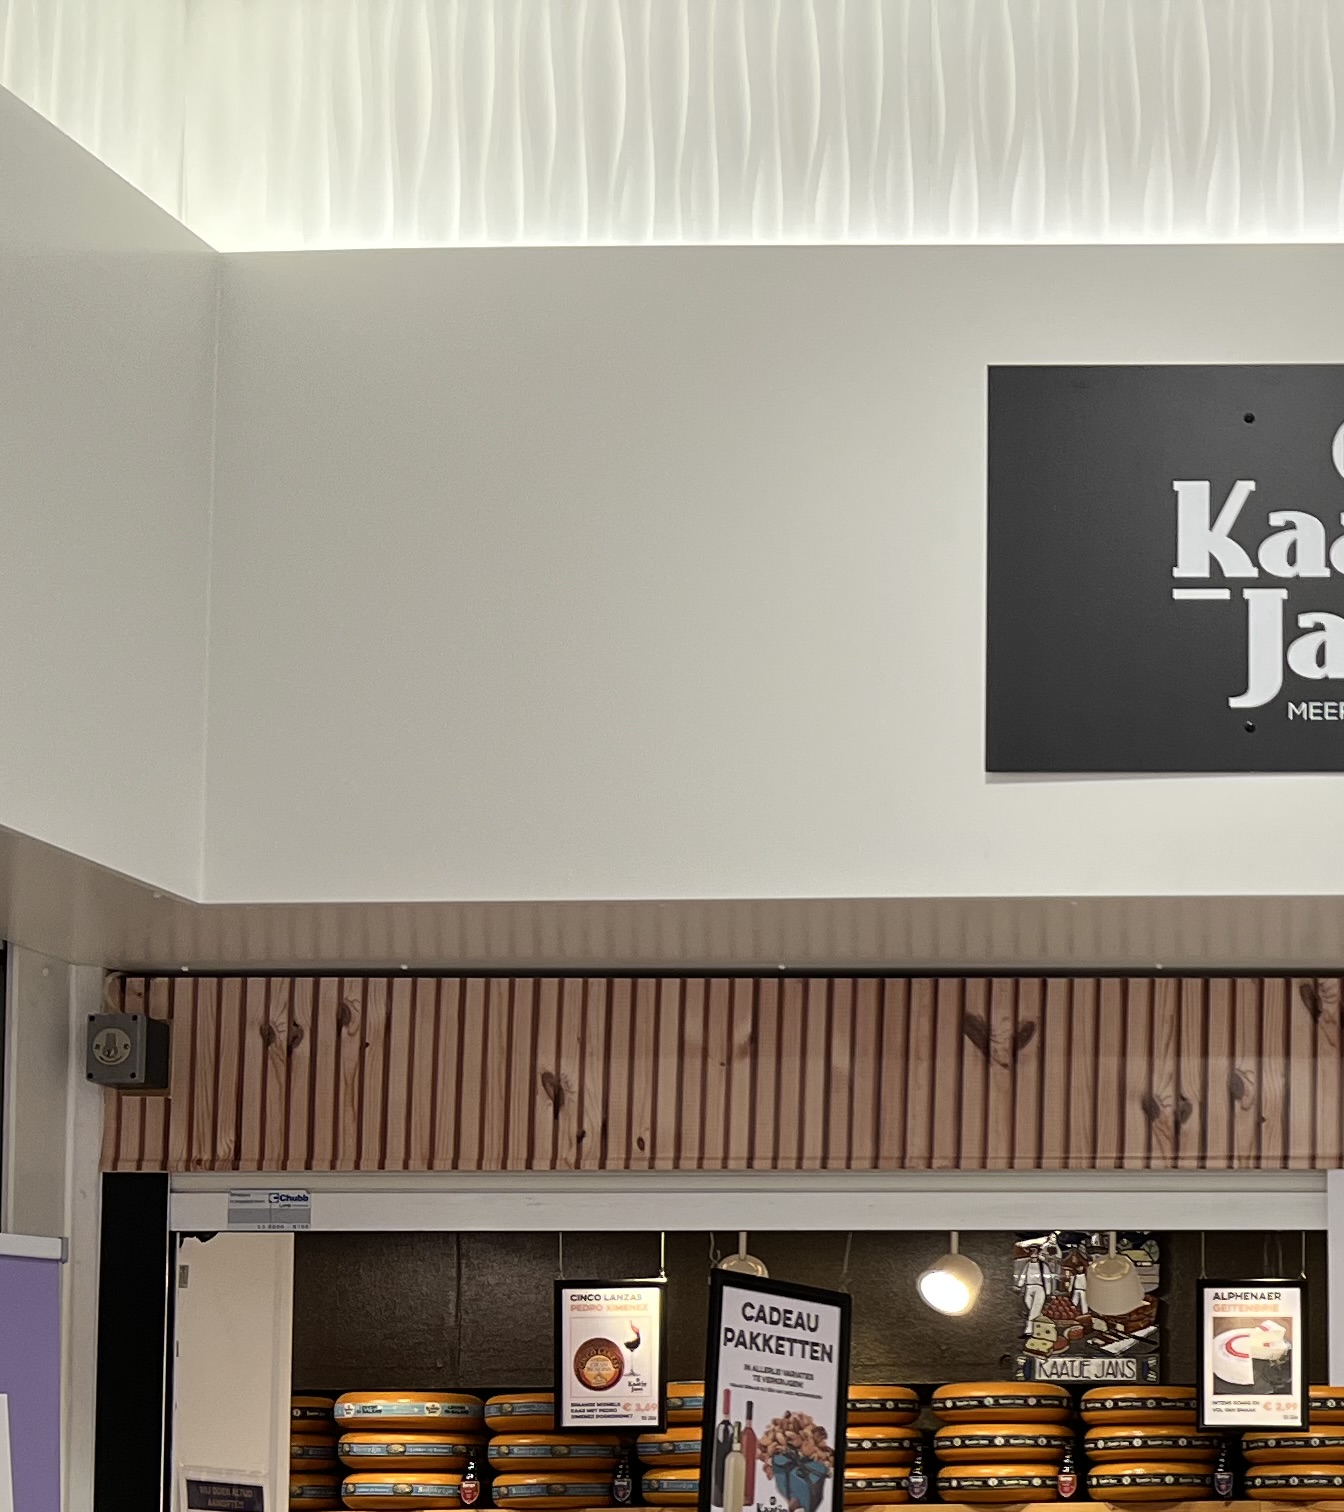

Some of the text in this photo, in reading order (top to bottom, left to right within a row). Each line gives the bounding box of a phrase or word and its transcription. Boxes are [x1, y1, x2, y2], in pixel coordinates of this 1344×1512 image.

[570, 1294, 601, 1302] CINCO
[1212, 1292, 1282, 1300] ALPHENAER
[741, 1301, 819, 1332] CADEAU
[723, 1327, 834, 1363] PAKKETTEN
[1094, 1360, 1136, 1379] JANS
